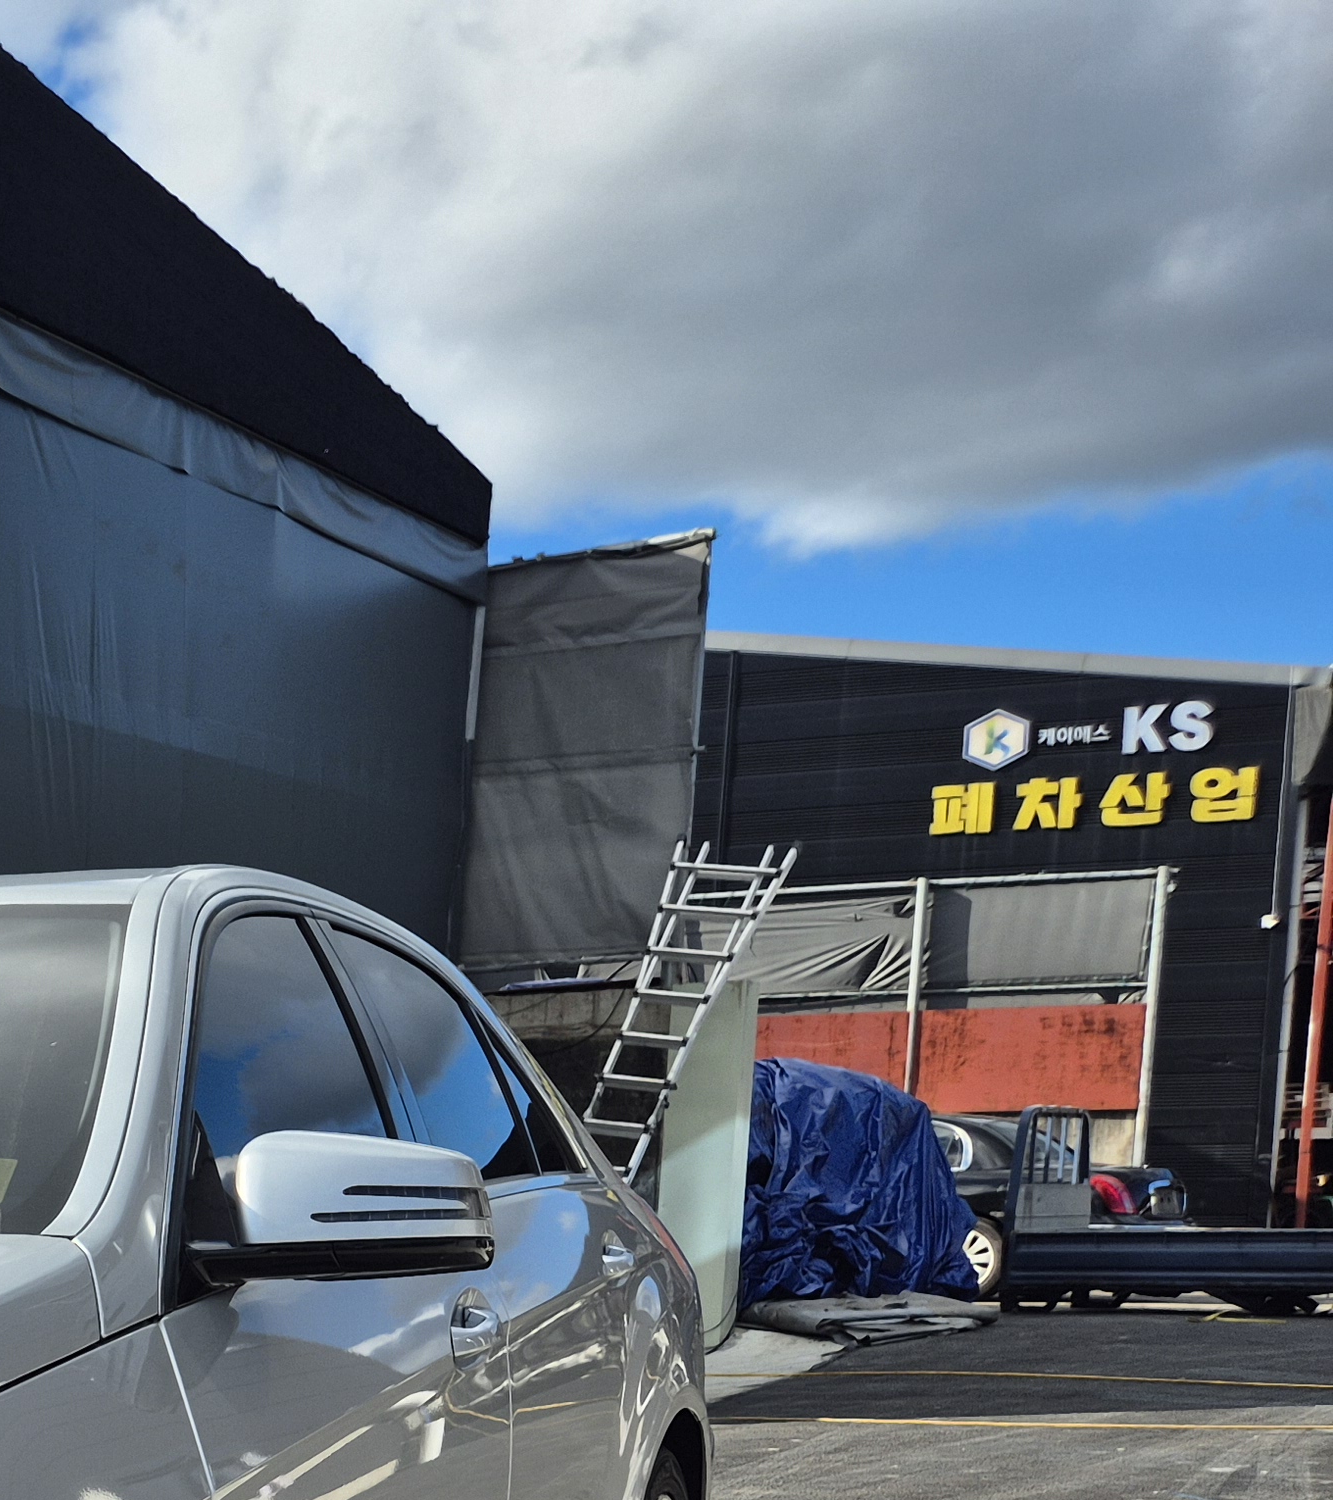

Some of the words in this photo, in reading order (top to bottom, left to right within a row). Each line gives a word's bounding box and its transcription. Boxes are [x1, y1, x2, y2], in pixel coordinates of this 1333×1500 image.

[1037, 724, 1112, 747] 케이에스
[1121, 700, 1215, 755] KS
[928, 765, 1262, 836] 폐차산업
